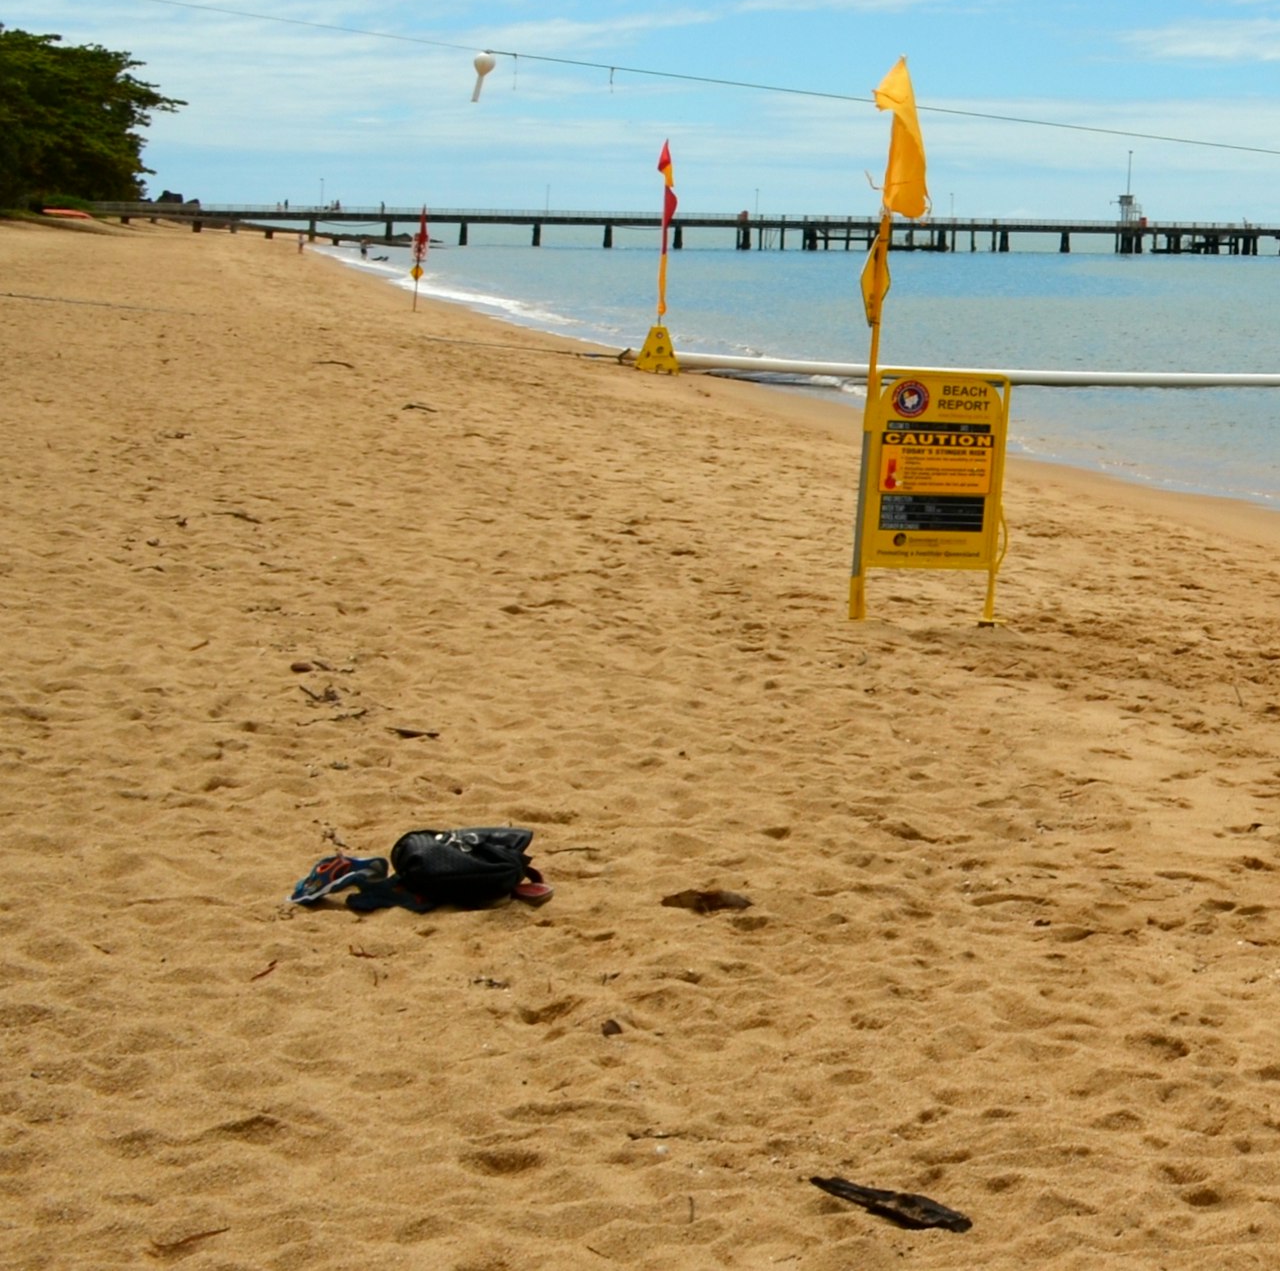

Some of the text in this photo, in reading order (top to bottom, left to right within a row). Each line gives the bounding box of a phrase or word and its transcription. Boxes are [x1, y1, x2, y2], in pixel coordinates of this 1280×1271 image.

[942, 385, 988, 397] BEACH
[937, 399, 990, 411] REPORT
[885, 433, 991, 446] CAUTION
